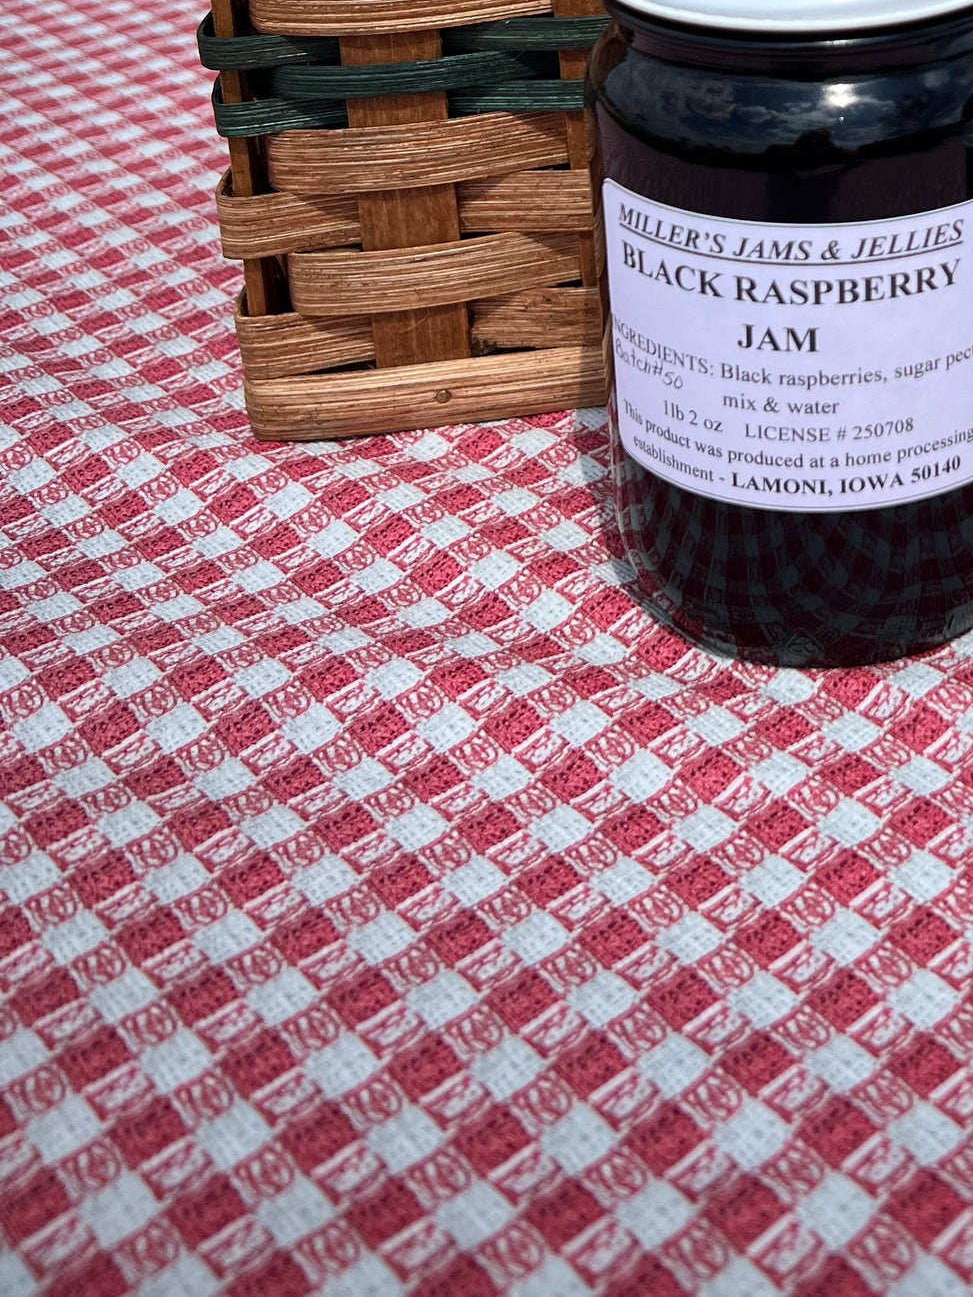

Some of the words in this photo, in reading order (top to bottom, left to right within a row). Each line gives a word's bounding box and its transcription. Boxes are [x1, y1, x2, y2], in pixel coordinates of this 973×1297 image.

[618, 202, 727, 255] MILLER'S
[732, 236, 813, 262] JAMS
[821, 239, 842, 261] &
[851, 218, 965, 260] JELLIES
[622, 238, 725, 299] BLACK
[733, 257, 961, 306] RASPBERRY
[737, 323, 819, 353] JAM
[721, 363, 773, 386] Black
[779, 366, 889, 392] raspberries,
[894, 356, 942, 379] sugar
[689, 409, 699, 426] 2
[704, 417, 724, 433] oz
[745, 422, 831, 443] LICENSE
[836, 427, 848, 441] #
[852, 416, 915, 441] 250708
[722, 392, 757, 412] mix
[763, 396, 780, 414] &
[788, 400, 840, 416] water
[623, 398, 644, 425] This
[645, 419, 691, 450] product
[694, 440, 724, 459] was
[727, 449, 804, 469] produced
[809, 454, 826, 469] at
[830, 457, 840, 468] a
[845, 450, 892, 467] home
[633, 434, 715, 482] establishment
[731, 471, 834, 497] LAMONI,
[840, 472, 906, 495] IOWA
[910, 454, 962, 484] 50140
